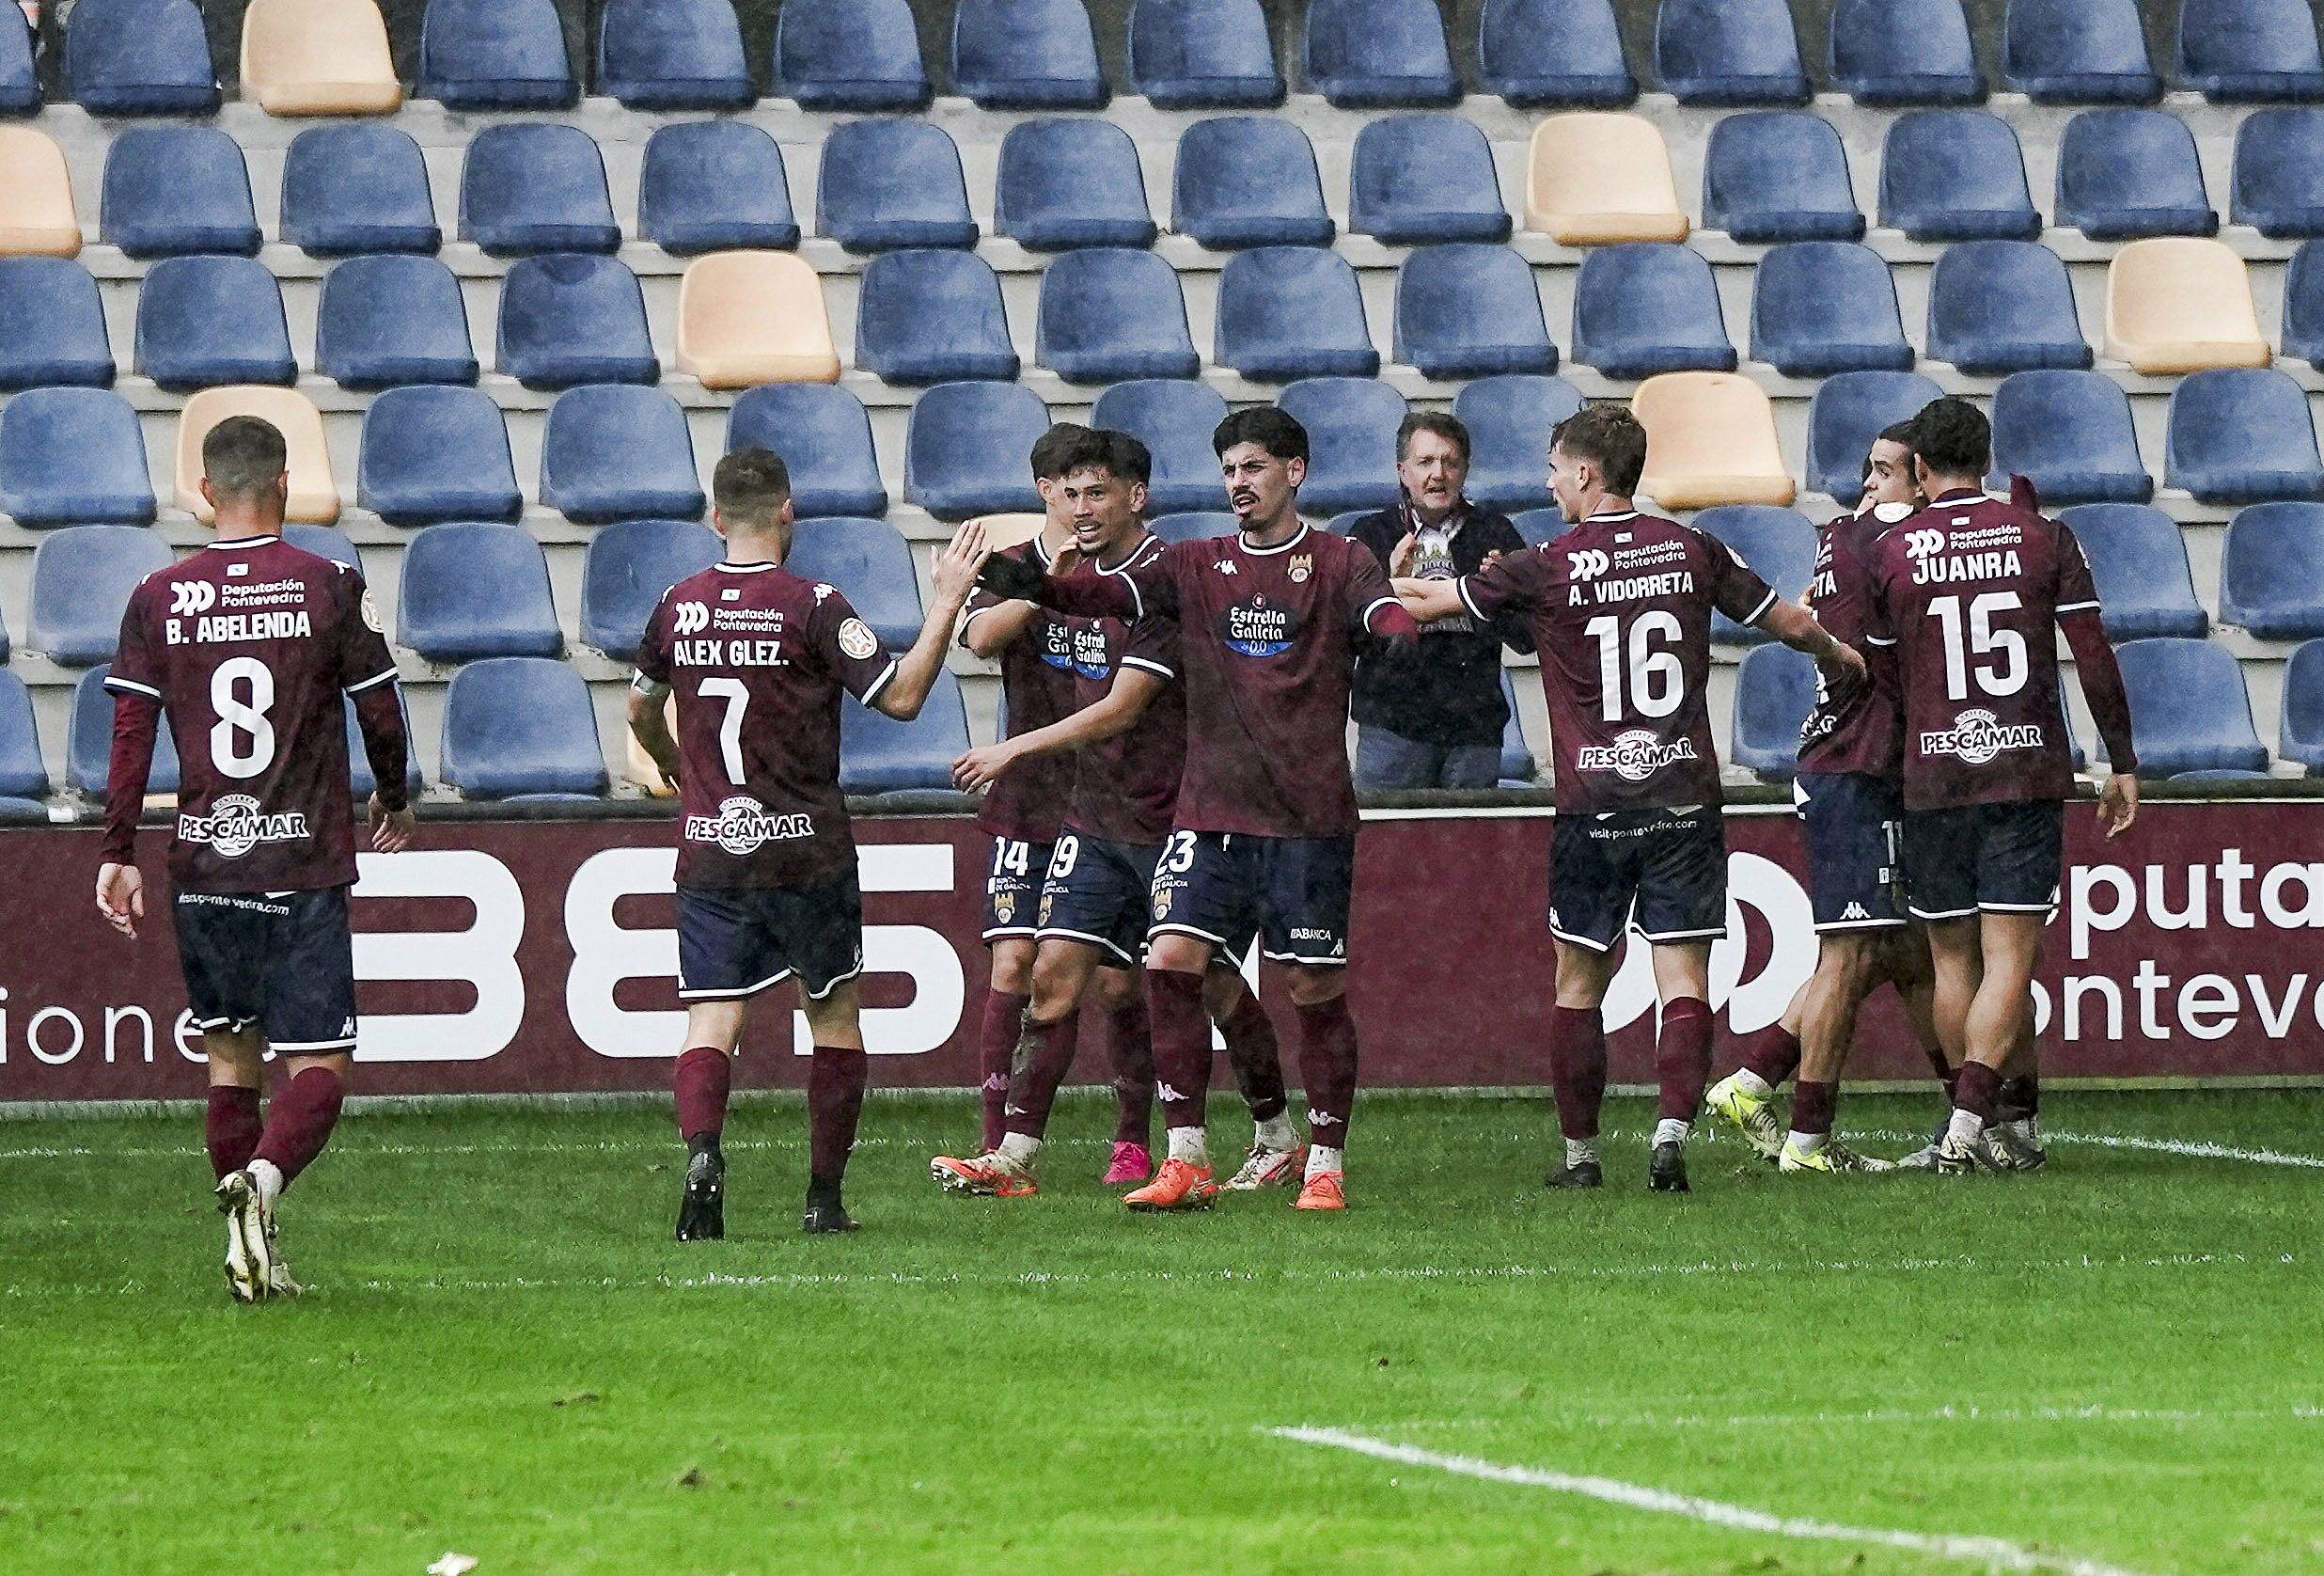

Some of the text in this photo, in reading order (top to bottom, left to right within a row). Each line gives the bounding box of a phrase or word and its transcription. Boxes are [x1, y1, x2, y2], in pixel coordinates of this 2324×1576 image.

[1949, 525, 2022, 542] Deputación
[1950, 535, 2022, 550] Pontevedra
[1613, 539, 1685, 561] Deputación
[1615, 551, 1687, 571] Pontevedra
[1912, 550, 2022, 585] JUANRA
[221, 578, 306, 597] Deputación
[221, 593, 306, 607] Pontevedra
[1568, 571, 1694, 607] A. VIDORRETA
[165, 611, 312, 645] B. ABELENDA
[713, 619, 783, 633] Pontevedra
[714, 607, 785, 622] Deputación
[1229, 607, 1287, 625] Estrella
[1231, 623, 1283, 640] Galicia
[1926, 591, 2029, 701] 15
[673, 639, 791, 667] ALEX GLEZ.
[1583, 610, 1685, 722] 16
[210, 656, 275, 779] 8
[697, 677, 750, 786] 7
[1577, 736, 1699, 770] PESCAMAR
[1920, 725, 2044, 754] PESCAMAR
[178, 812, 311, 843] PESCAMAR
[684, 812, 816, 843] PESCAMAR
[993, 835, 1029, 876] 14
